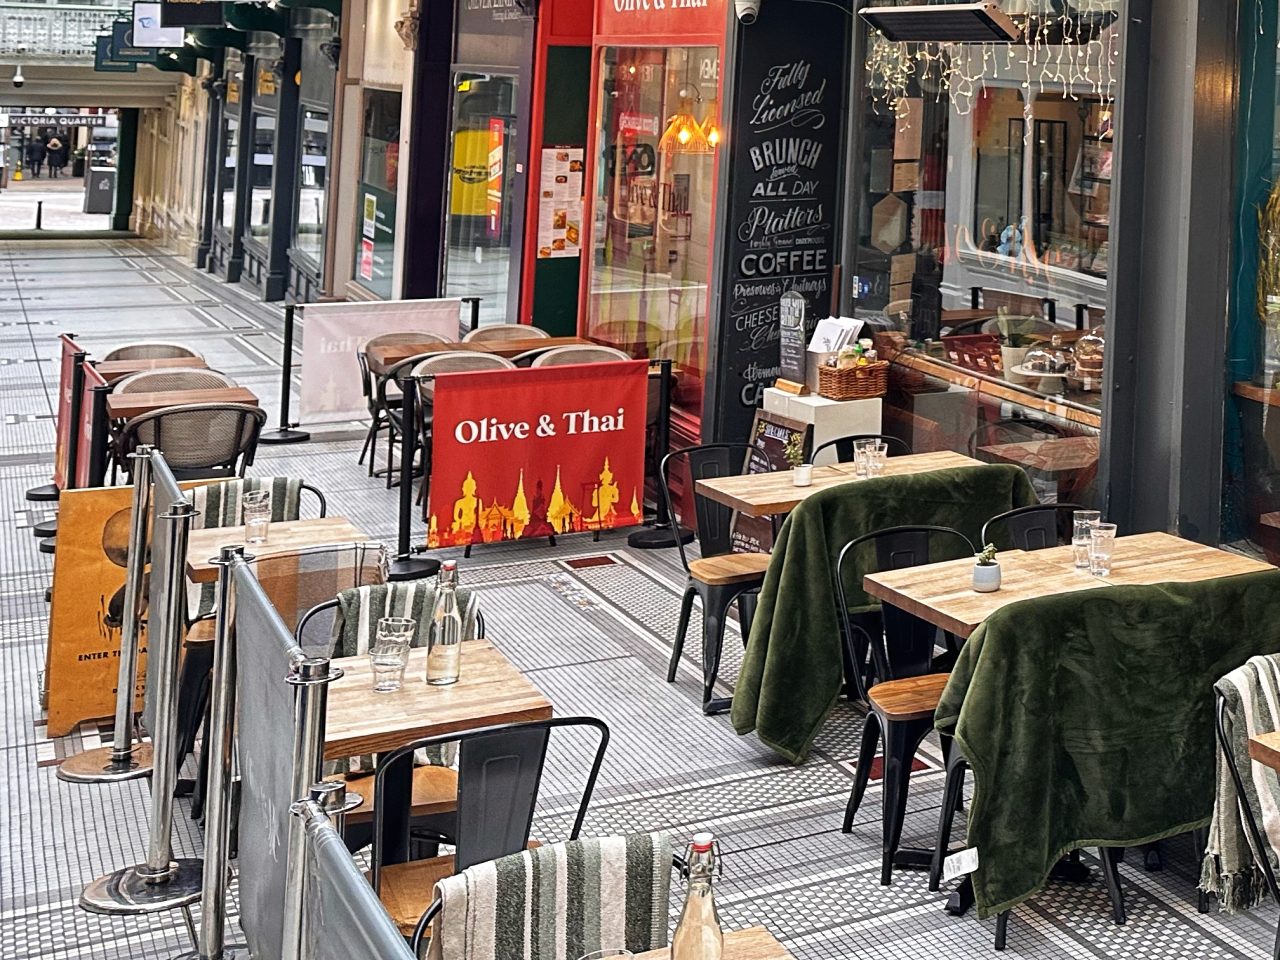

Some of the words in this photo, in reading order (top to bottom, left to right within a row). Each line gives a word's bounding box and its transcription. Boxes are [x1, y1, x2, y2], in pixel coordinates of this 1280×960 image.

[761, 60, 811, 95] Fully
[749, 79, 827, 125] Licensed
[10, 117, 57, 125] VICTORIA
[60, 117, 103, 125] QUARTER
[748, 137, 823, 172] BRUNCH
[752, 181, 788, 197] ALL
[792, 180, 820, 195] DAY
[738, 203, 823, 242] Platters
[740, 249, 827, 276] COFFEE
[454, 416, 530, 445] Olive
[535, 413, 556, 437] &
[562, 407, 625, 435] Thai
[78, 651, 109, 661] ENTER
